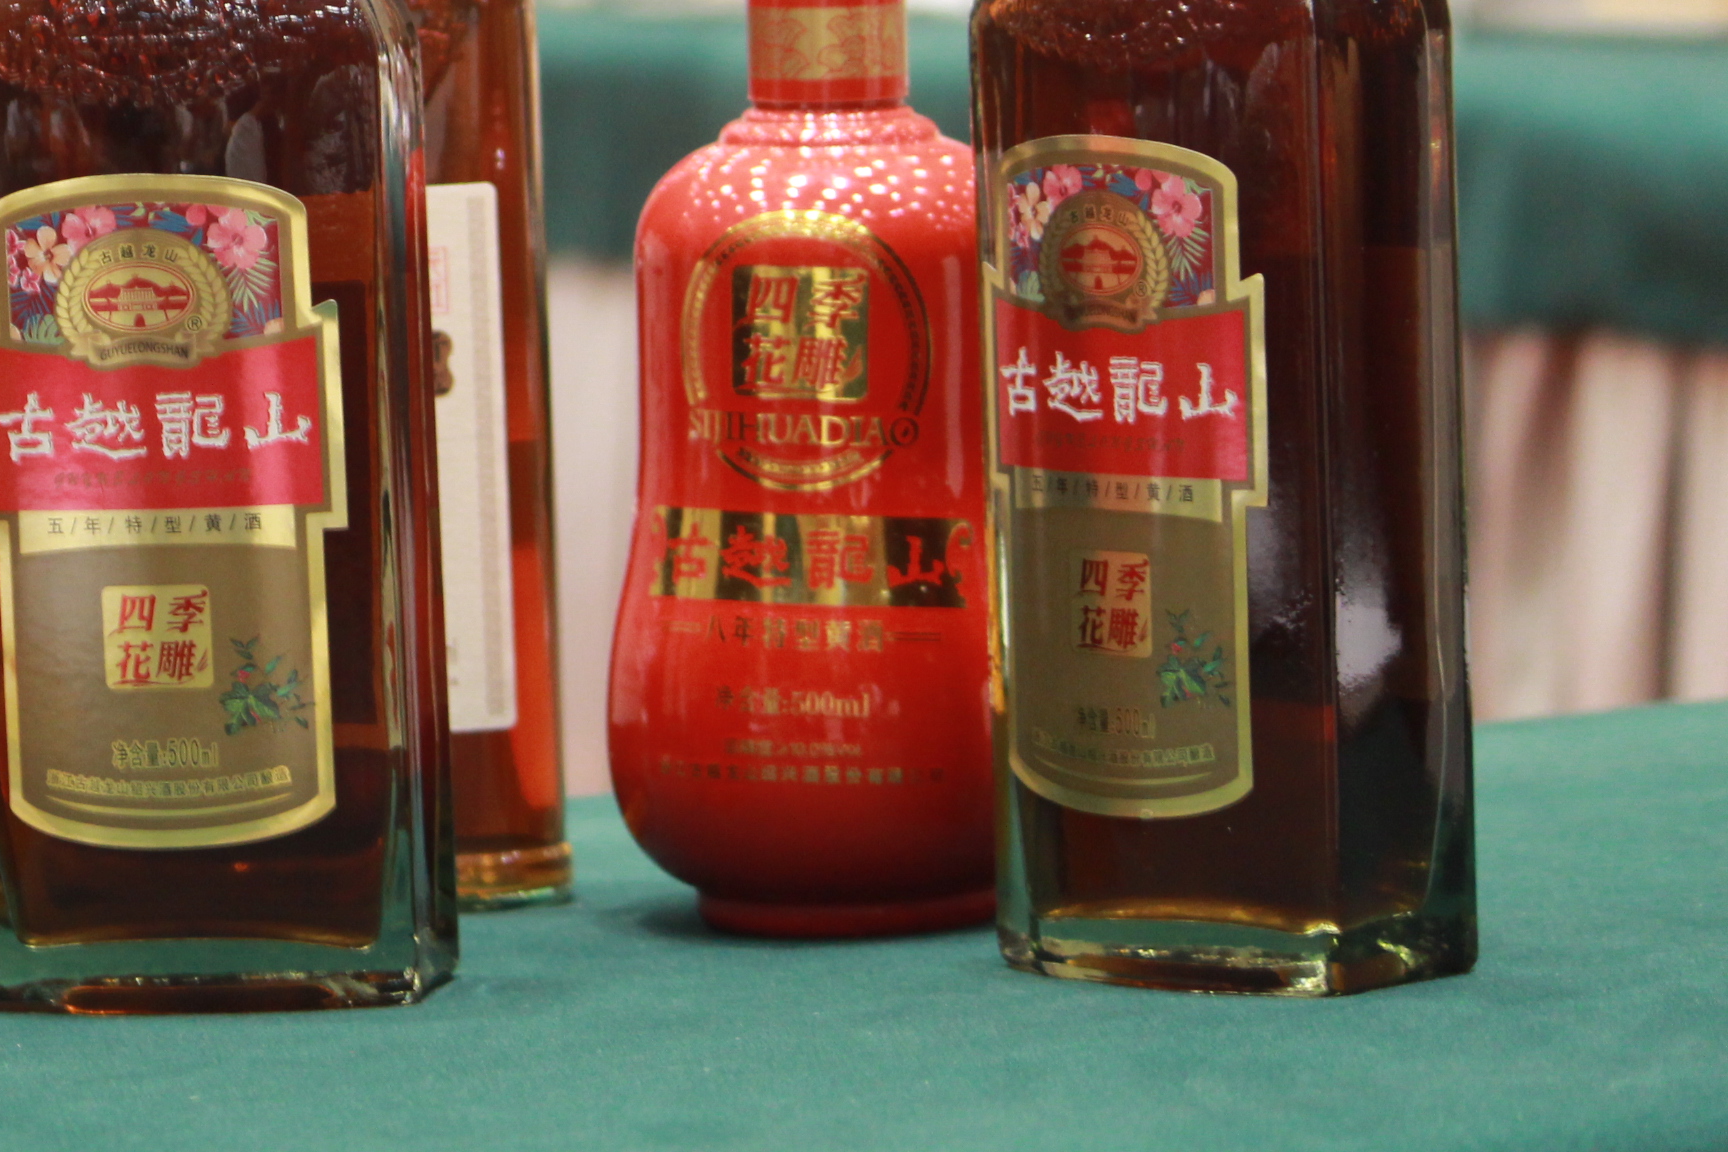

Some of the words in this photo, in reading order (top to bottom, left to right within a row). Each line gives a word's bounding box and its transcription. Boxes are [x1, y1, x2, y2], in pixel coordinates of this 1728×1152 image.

[100, 244, 179, 264] 古越龙山
[747, 274, 865, 329] 四季
[741, 333, 850, 391] 花雕
[1080, 558, 1149, 600] 四季
[117, 589, 208, 634] 四季
[1078, 606, 1140, 647] 花雕
[118, 640, 198, 684] 花雕
